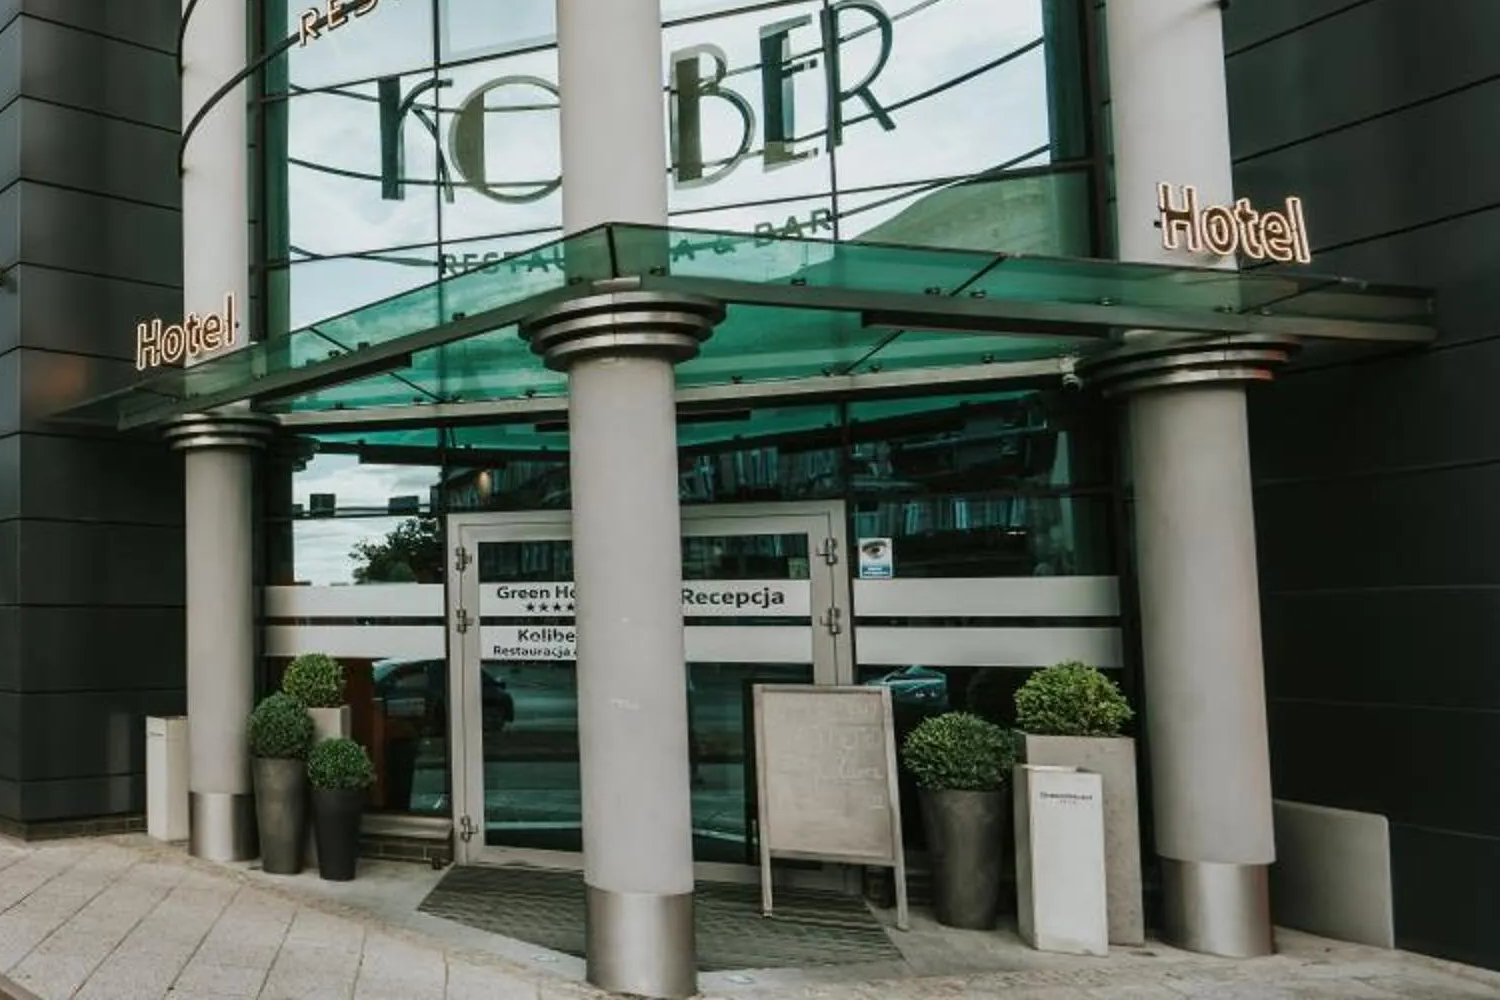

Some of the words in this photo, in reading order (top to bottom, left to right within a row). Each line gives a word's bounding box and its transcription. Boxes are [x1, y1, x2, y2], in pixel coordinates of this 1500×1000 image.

[1157, 180, 1311, 264] Hotel
[136, 292, 236, 371] Hotel
[496, 585, 550, 599] Green
[681, 587, 785, 609] Recepcja
[493, 645, 571, 658] Restauracja
